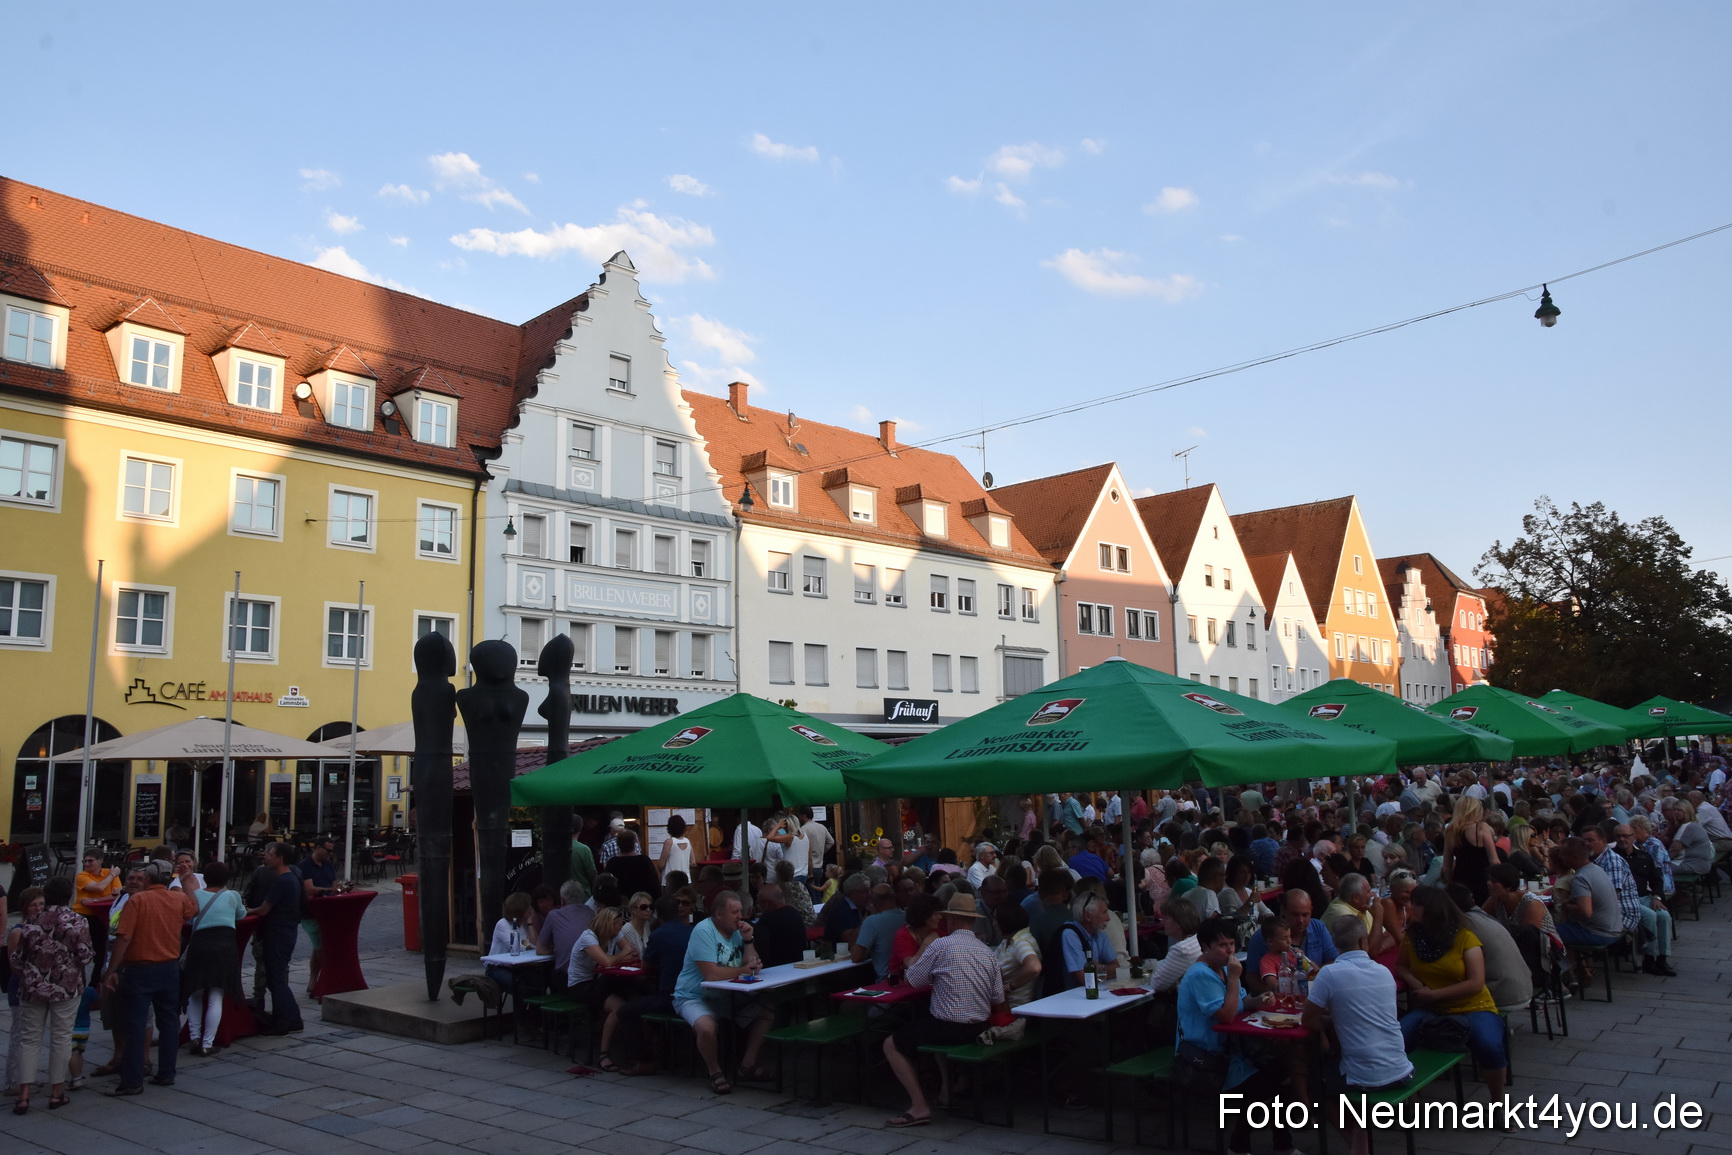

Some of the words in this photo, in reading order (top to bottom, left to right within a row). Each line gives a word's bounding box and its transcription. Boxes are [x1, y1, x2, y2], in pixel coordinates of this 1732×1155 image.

[573, 584, 625, 604] BRILLEN
[626, 590, 672, 609] WEBER
[160, 680, 207, 701] CAFÉ
[208, 689, 227, 702] AM
[571, 693, 622, 714] RILLEN
[623, 695, 681, 716] WEBER
[887, 699, 938, 722] frühauf
[977, 729, 1083, 746] Neumarkter
[621, 752, 704, 763] Neumarkter
[943, 739, 1091, 760] Lammsbräu
[592, 761, 705, 775] Lammsbräu
